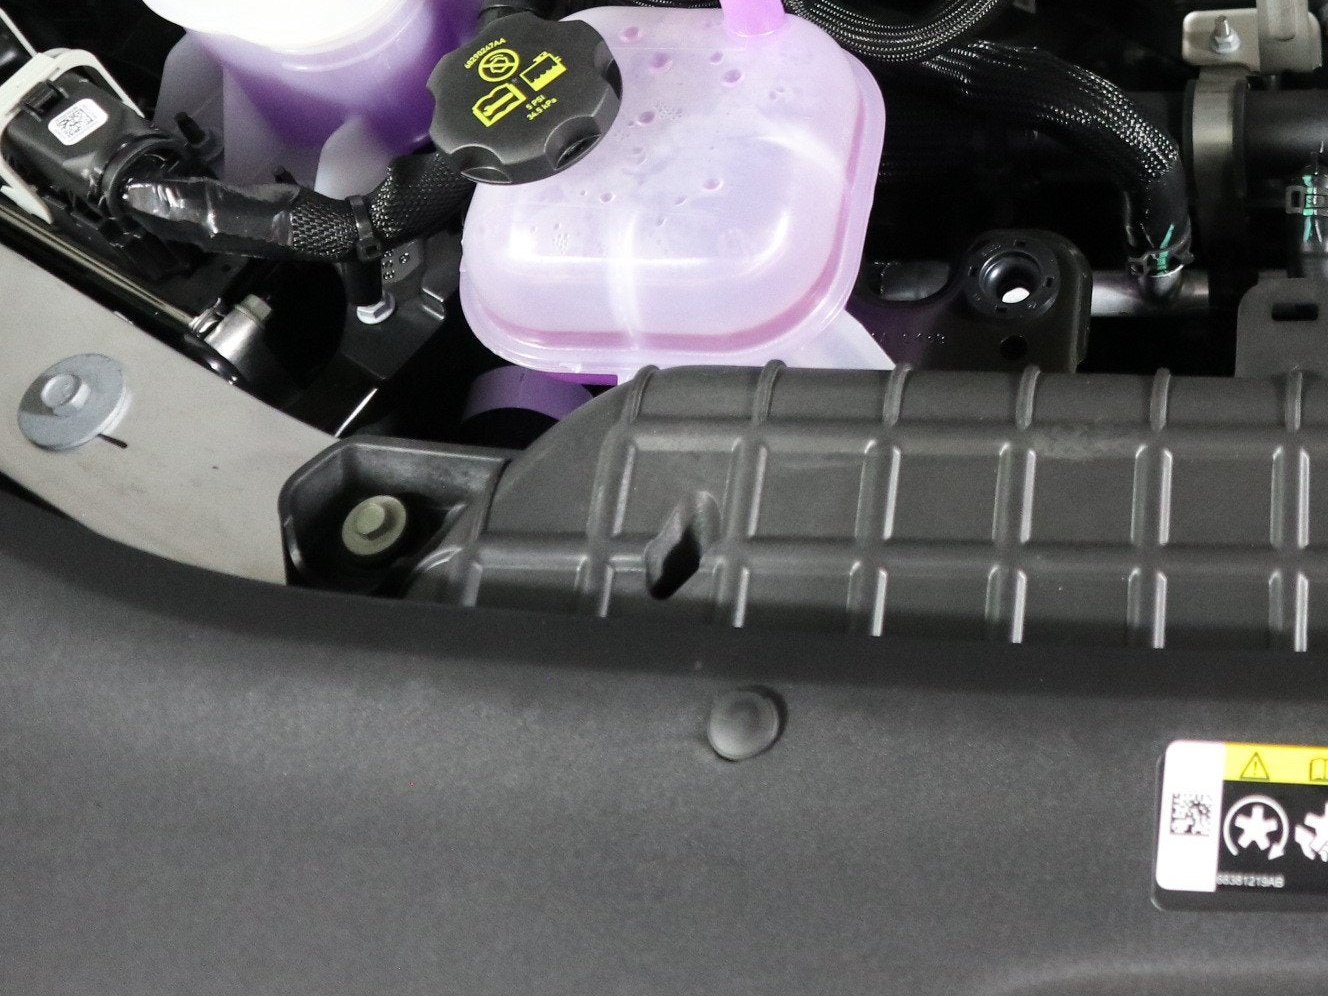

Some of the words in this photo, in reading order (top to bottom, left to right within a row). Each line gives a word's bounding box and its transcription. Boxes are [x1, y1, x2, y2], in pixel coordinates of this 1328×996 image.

[525, 103, 533, 111] 5
[531, 94, 547, 107] PSI
[526, 107, 544, 121] 34.5
[542, 97, 558, 110] kPa
